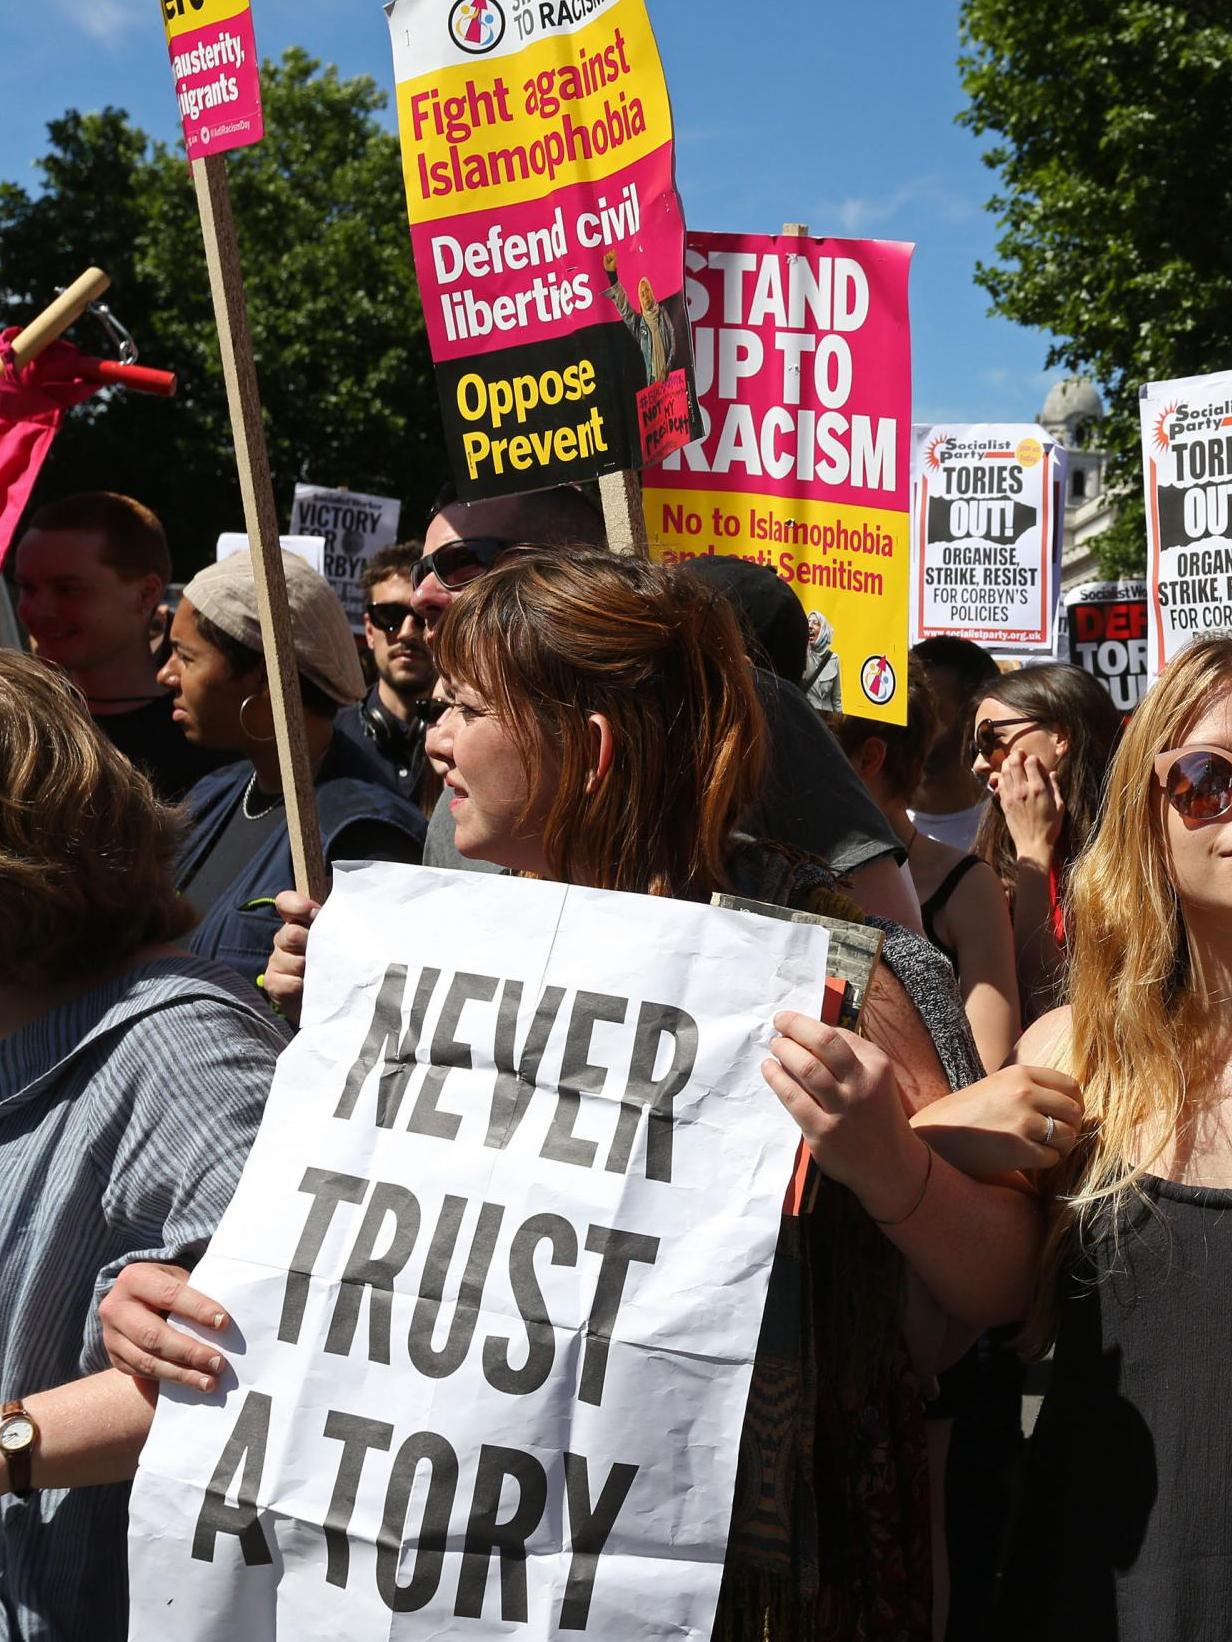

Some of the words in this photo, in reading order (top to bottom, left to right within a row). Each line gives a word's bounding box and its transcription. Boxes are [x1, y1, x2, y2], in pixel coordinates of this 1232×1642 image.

[514, 9, 534, 40] TO
[173, 32, 245, 79] austerity,
[411, 78, 513, 143] Fight
[523, 28, 630, 119] against
[417, 92, 646, 200] Islamophobia
[431, 207, 567, 285] Defend
[577, 182, 640, 249] civil
[440, 271, 594, 342] liberties
[686, 253, 869, 331] STAND
[455, 358, 596, 430] Oppose
[774, 334, 853, 410] TO
[463, 407, 608, 480] Prevent
[663, 405, 898, 491] RACISM
[945, 438, 1011, 450] Socialist
[1169, 418, 1222, 440] Party
[940, 451, 985, 463] Party
[943, 465, 1023, 495] TORIES
[299, 502, 382, 534] VICTORY
[662, 504, 702, 535] No
[712, 508, 740, 537] to
[750, 509, 893, 557] Islamophobia
[949, 500, 1015, 537] OUT!
[926, 567, 980, 587] STRIKE,
[983, 568, 1038, 587] RESIST
[943, 547, 1020, 567] ORGANISE,
[933, 588, 958, 604] FOR
[964, 588, 1028, 605] CORBYN'S
[951, 606, 1009, 622] POLICIES
[1158, 577, 1223, 606] STRIKE,
[1170, 607, 1198, 630] FOR
[332, 962, 700, 1183] NEVER
[275, 1166, 660, 1407] TRUST
[190, 1390, 275, 1568] A
[321, 1409, 640, 1632] TORY
